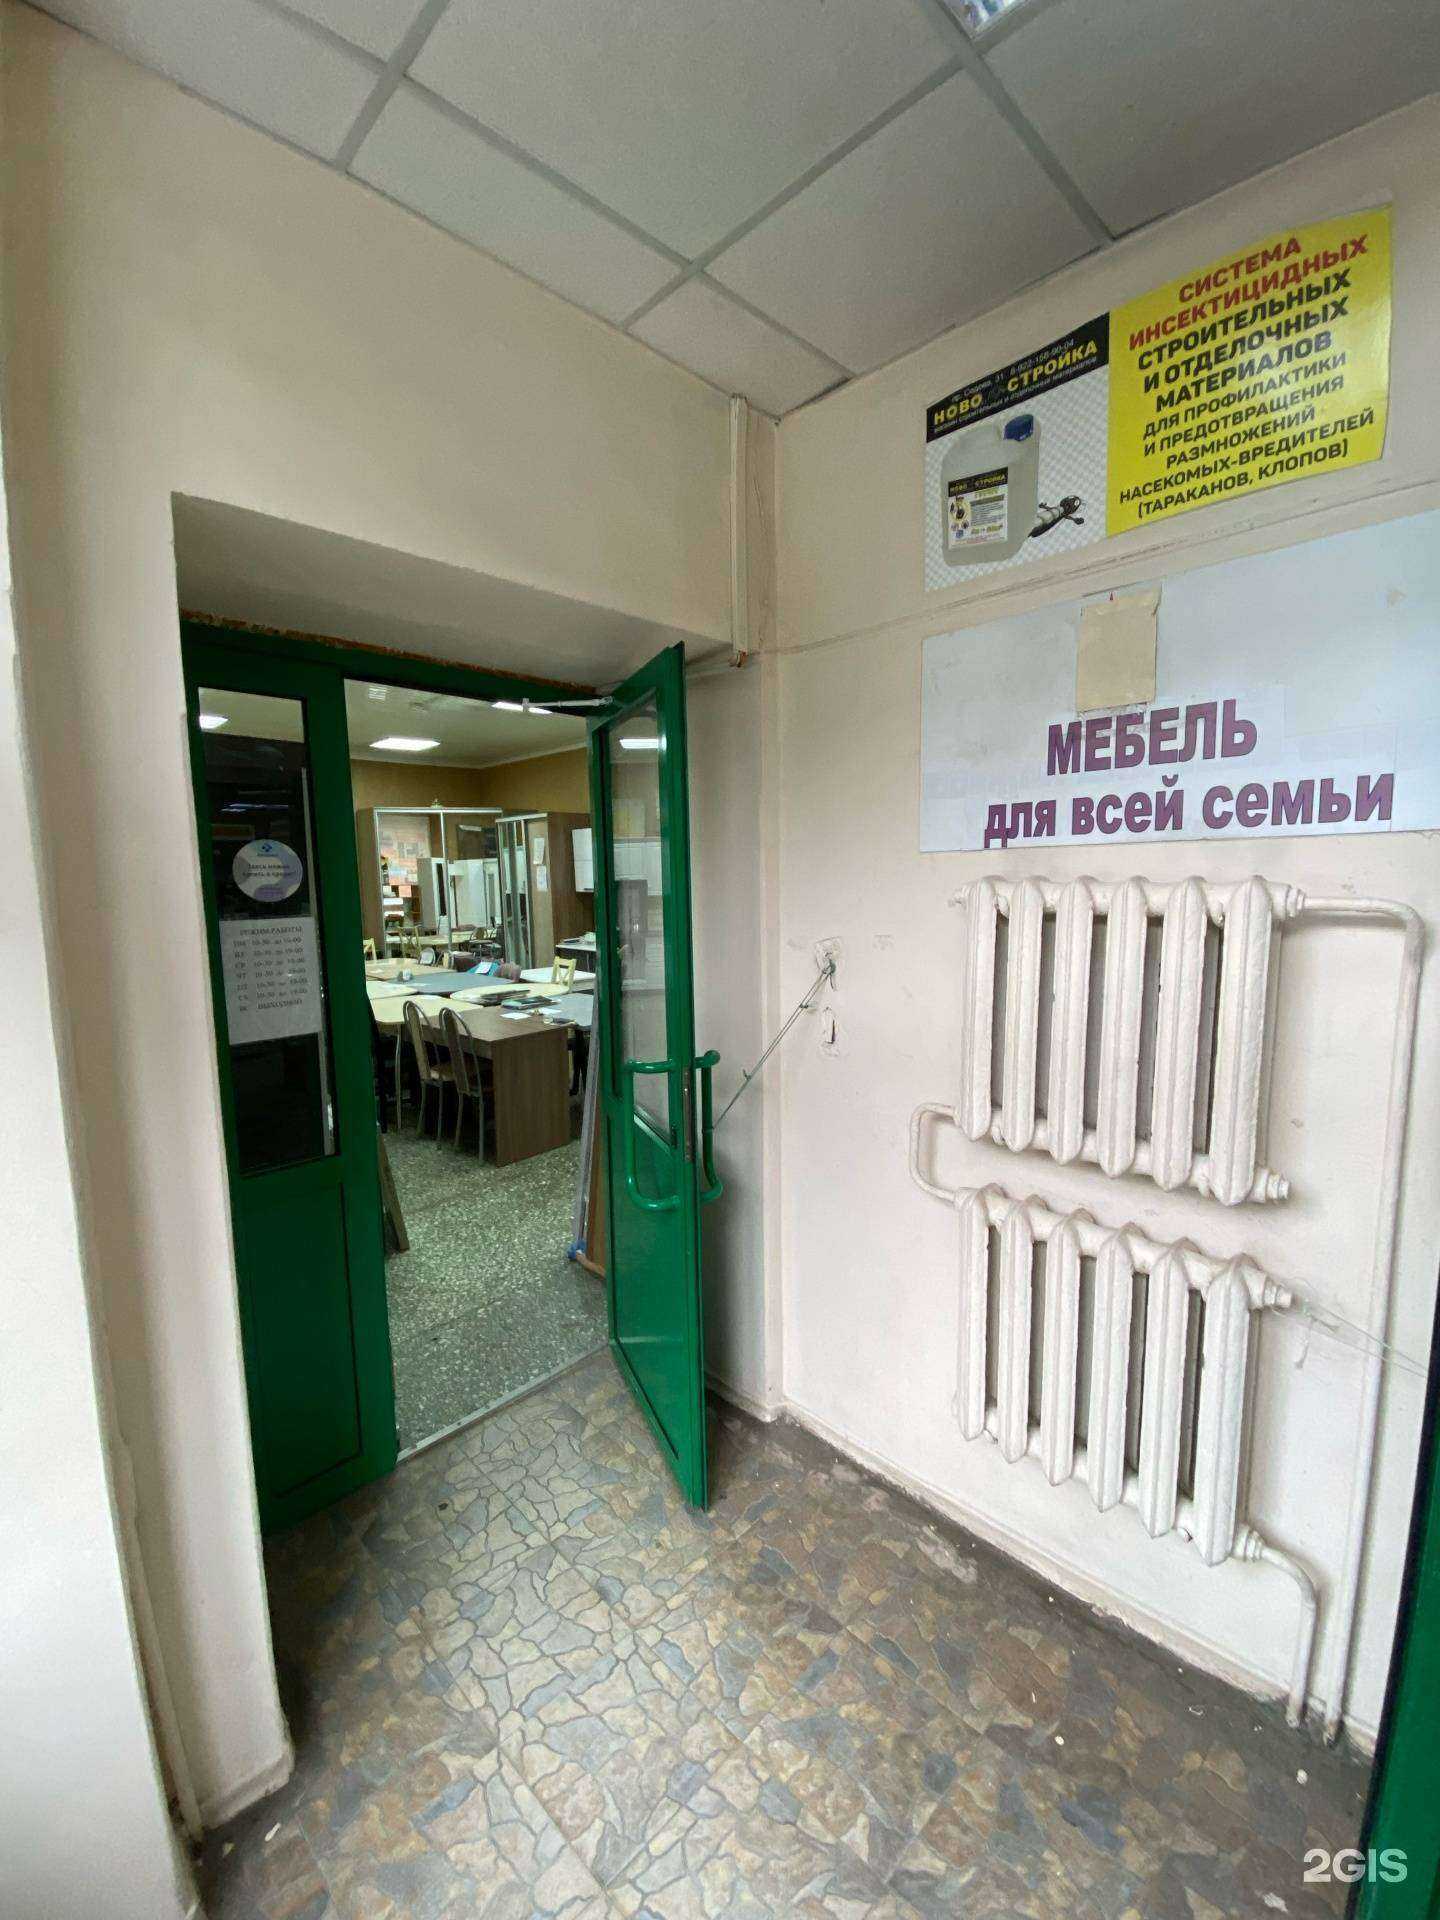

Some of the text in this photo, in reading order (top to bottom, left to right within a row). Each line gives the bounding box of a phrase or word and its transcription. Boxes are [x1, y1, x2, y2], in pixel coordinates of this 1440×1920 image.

[1129, 234, 1368, 350] ИНСЕКТИЦИДНЫХ
[1178, 237, 1302, 303] СИСТЕМА
[1138, 268, 1351, 370] СТРОИТЕЛЬНЫХ
[1144, 296, 1349, 394] И ОТДЕЛОЧНЫХ
[933, 394, 983, 424] НОВО
[1143, 352, 1347, 440] ДЛЯ ПРОФИЛАКТИКИ
[1156, 331, 1333, 413] МАТЕРИАЛОВ
[1120, 407, 1374, 504] НАСЕКОМЫХ-ВРЕДИТЕЛЕЙ
[1144, 374, 1344, 457] И ПРЕДОТВРАЩЕНИЯ
[1166, 404, 1316, 469] РАЗМНОЖЕНИЙ
[1138, 438, 1348, 519] (ТАРАКАНОВ, КЛОПОВ)
[1047, 699, 1258, 776] МЕБЕЛЬ
[983, 773, 1395, 849] для всей семьи
